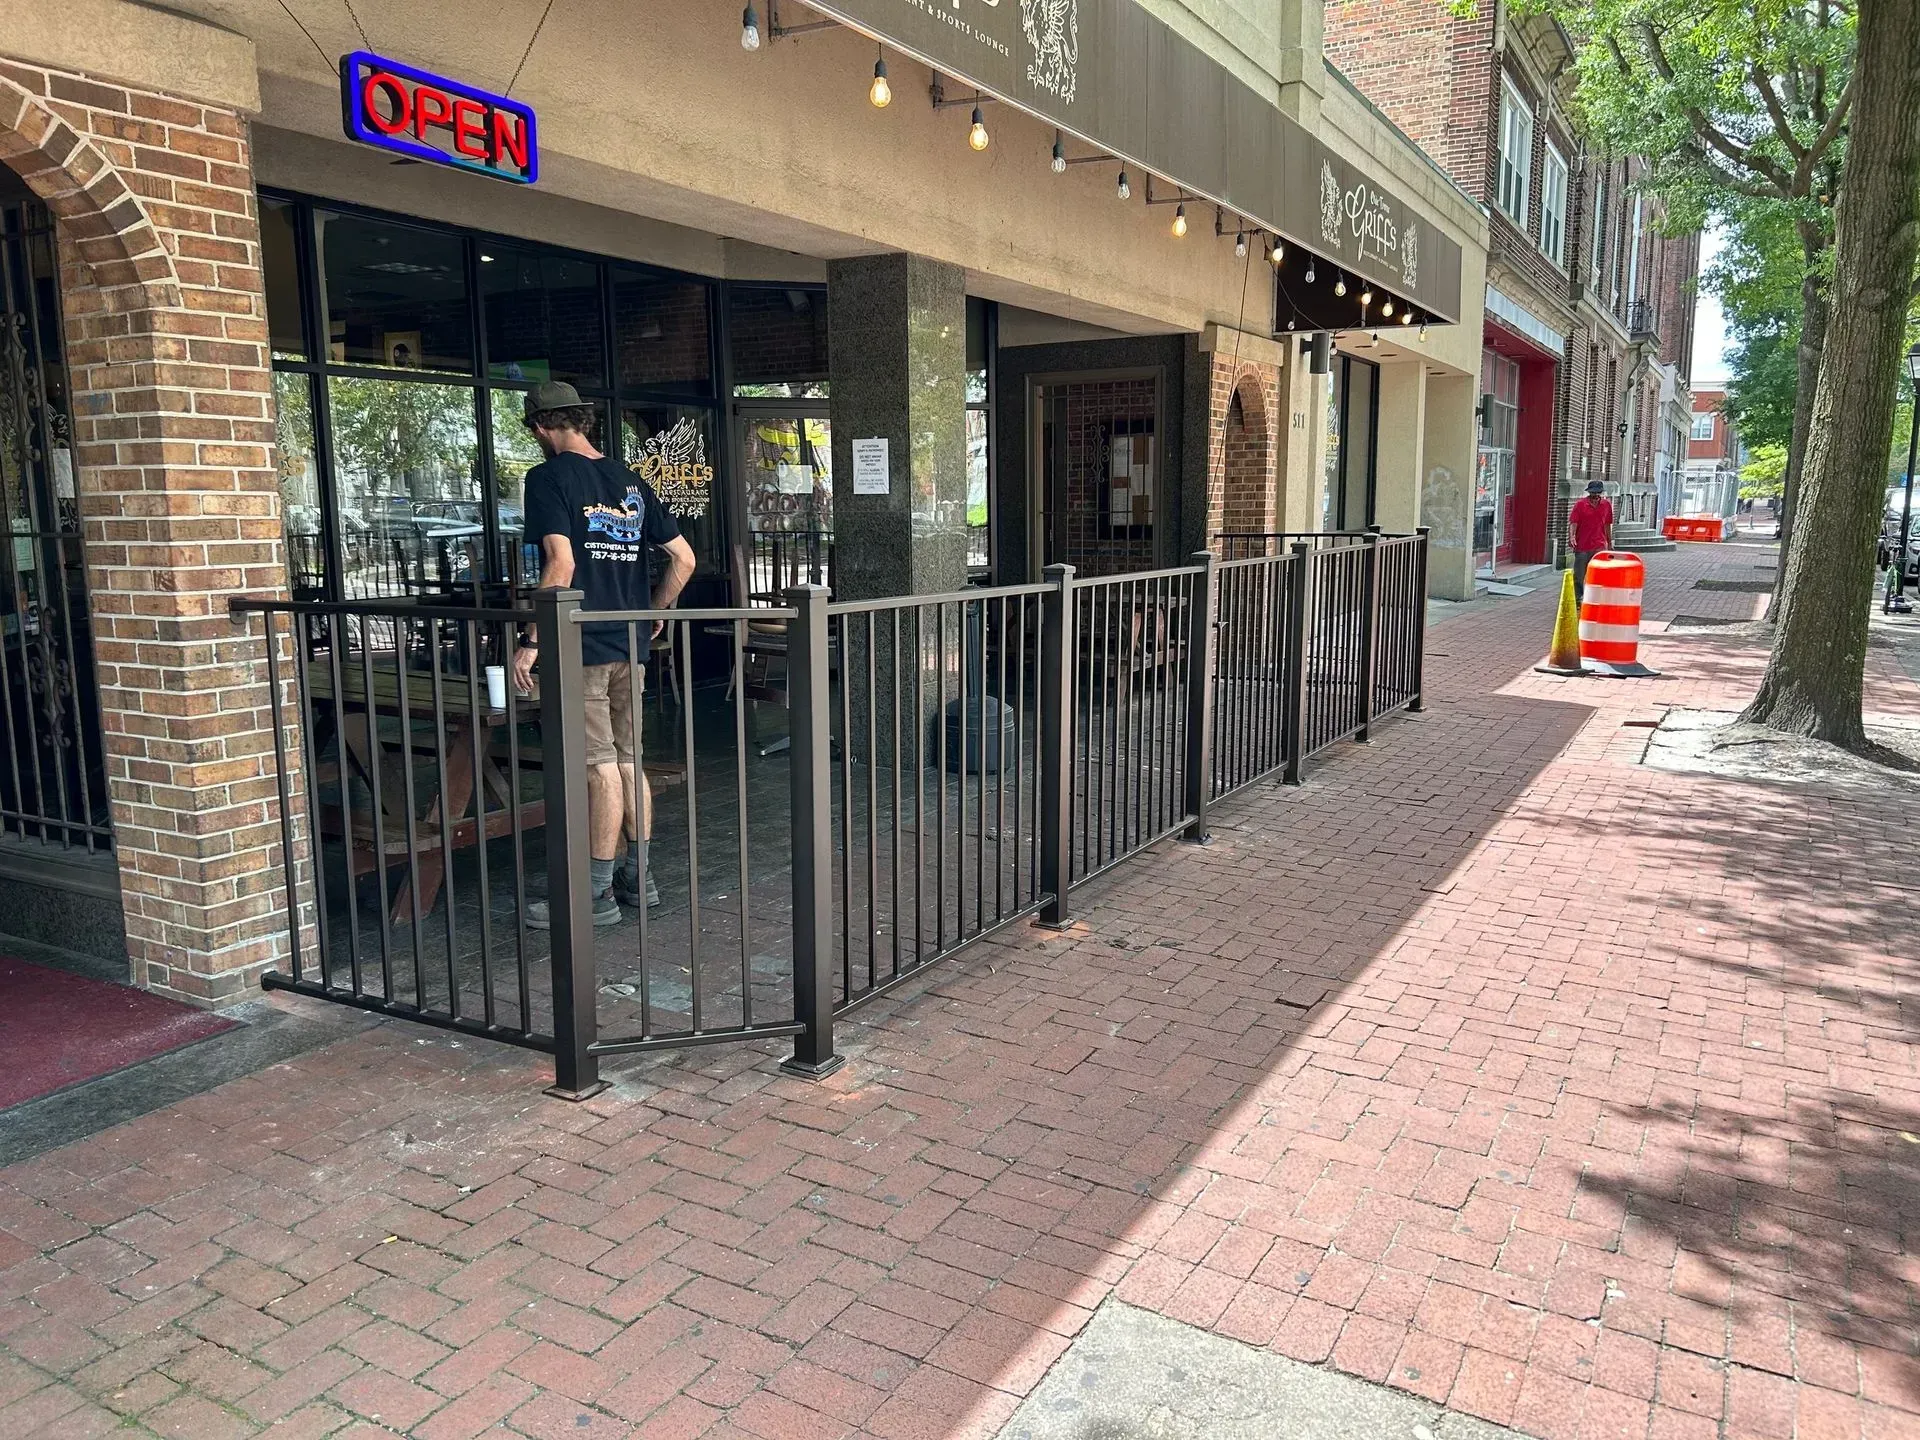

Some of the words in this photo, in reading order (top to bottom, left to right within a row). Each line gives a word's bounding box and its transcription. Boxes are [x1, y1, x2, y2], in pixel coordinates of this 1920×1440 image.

[927, 4, 934, 16] &
[937, 9, 970, 34] SPORTS
[974, 29, 1009, 57] LOUNGE
[363, 71, 527, 168] OPEN
[1293, 412, 1304, 429] 511
